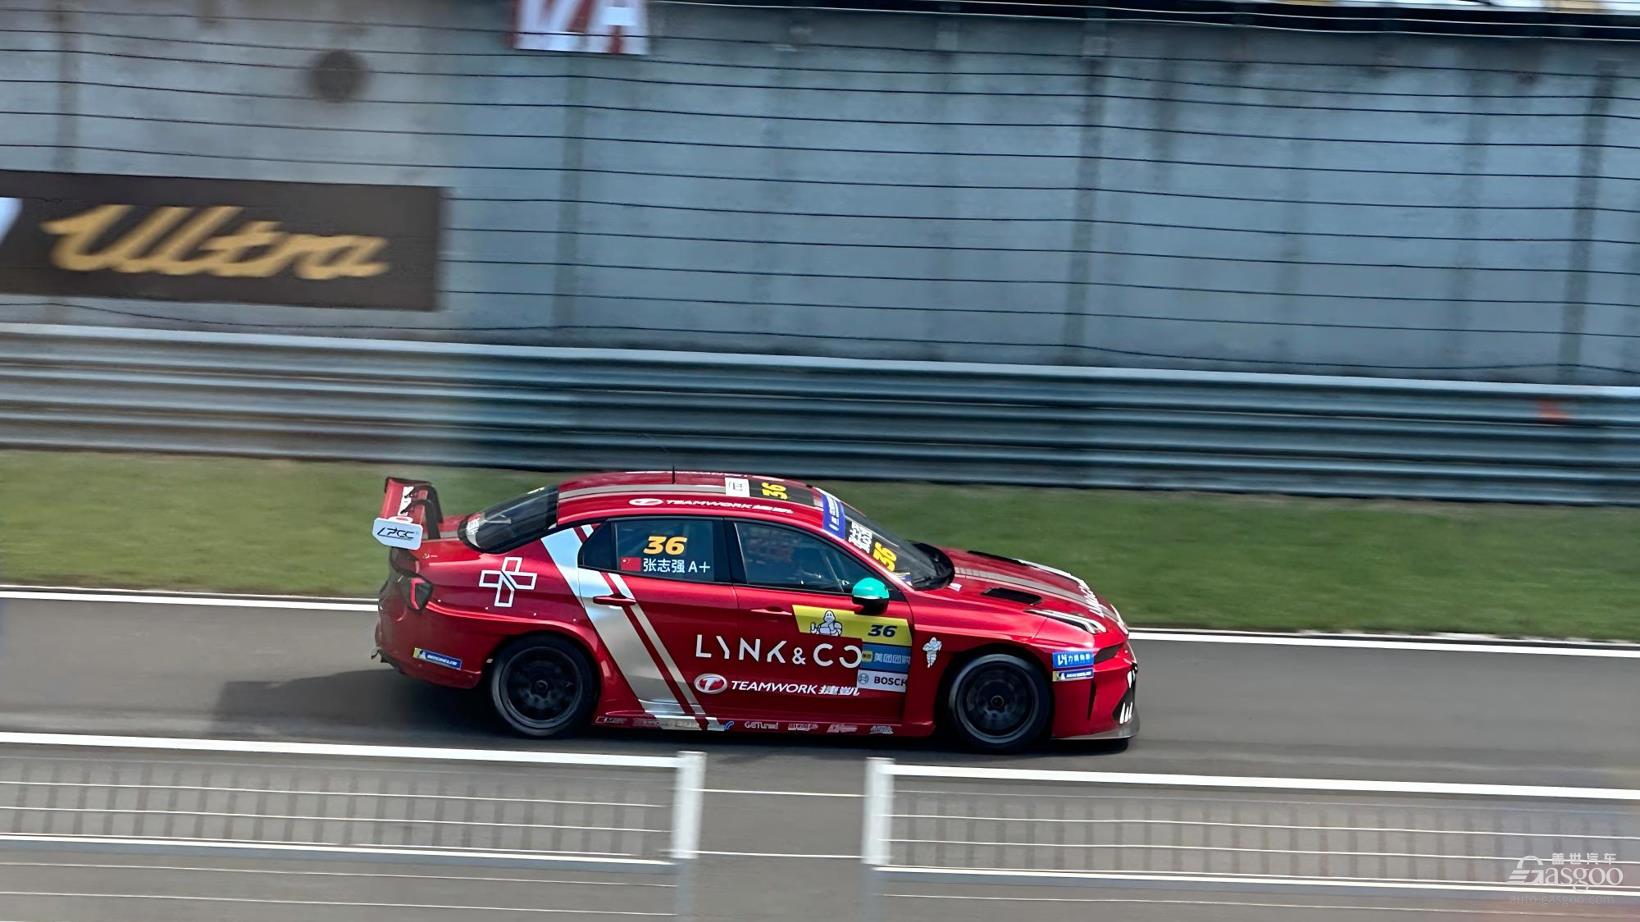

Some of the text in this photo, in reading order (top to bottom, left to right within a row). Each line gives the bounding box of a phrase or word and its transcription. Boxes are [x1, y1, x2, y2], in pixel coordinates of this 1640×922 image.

[40, 204, 390, 280] Ultra
[762, 481, 788, 501] 36
[643, 535, 688, 556] 36
[643, 557, 711, 573] 张志强 A+
[872, 541, 898, 572] 36
[868, 623, 897, 638] 36
[731, 680, 816, 694] TEAMWORK
[874, 676, 908, 686] BOSCH
